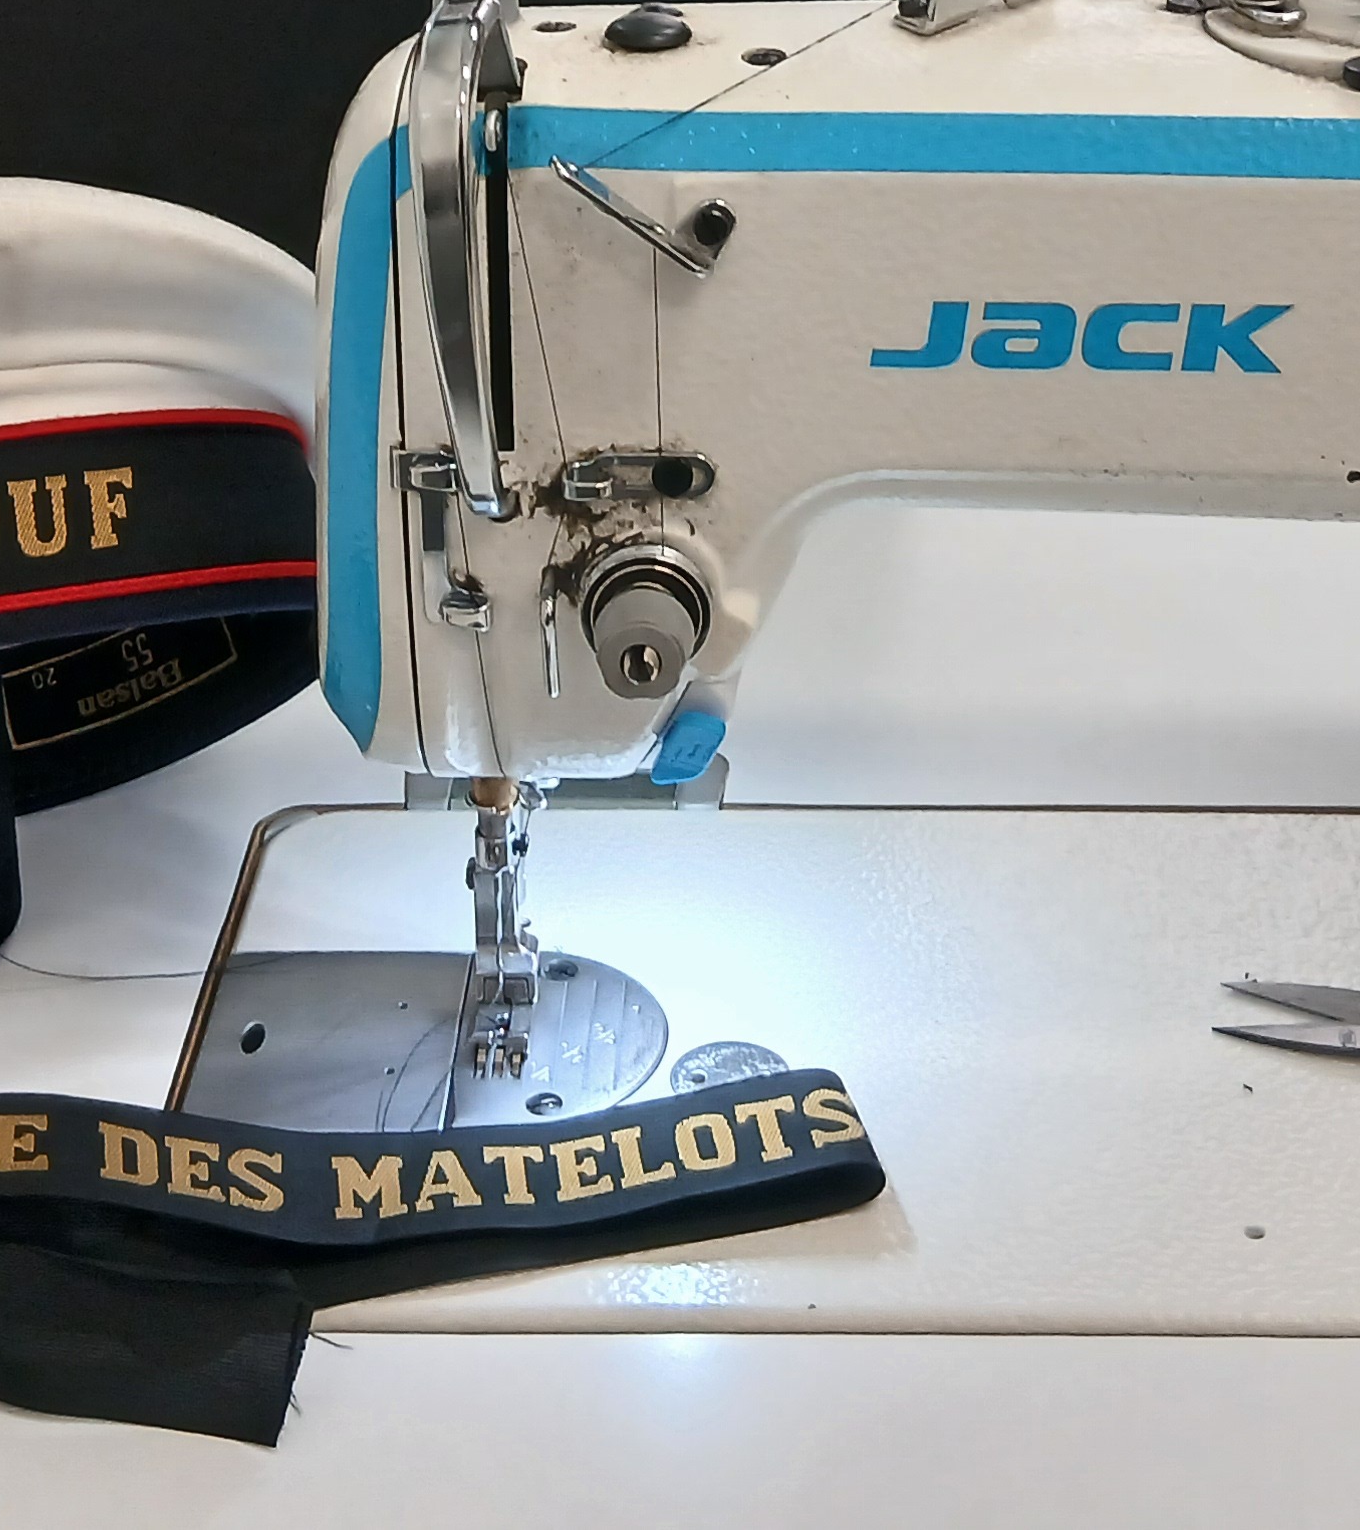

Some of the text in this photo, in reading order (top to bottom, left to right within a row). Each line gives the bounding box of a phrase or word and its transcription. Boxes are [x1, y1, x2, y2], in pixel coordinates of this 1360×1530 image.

[31, 667, 58, 690] 20
[76, 657, 184, 717] Balsan
[98, 1120, 285, 1214] DES
[331, 1087, 867, 1222] MATELOTS
